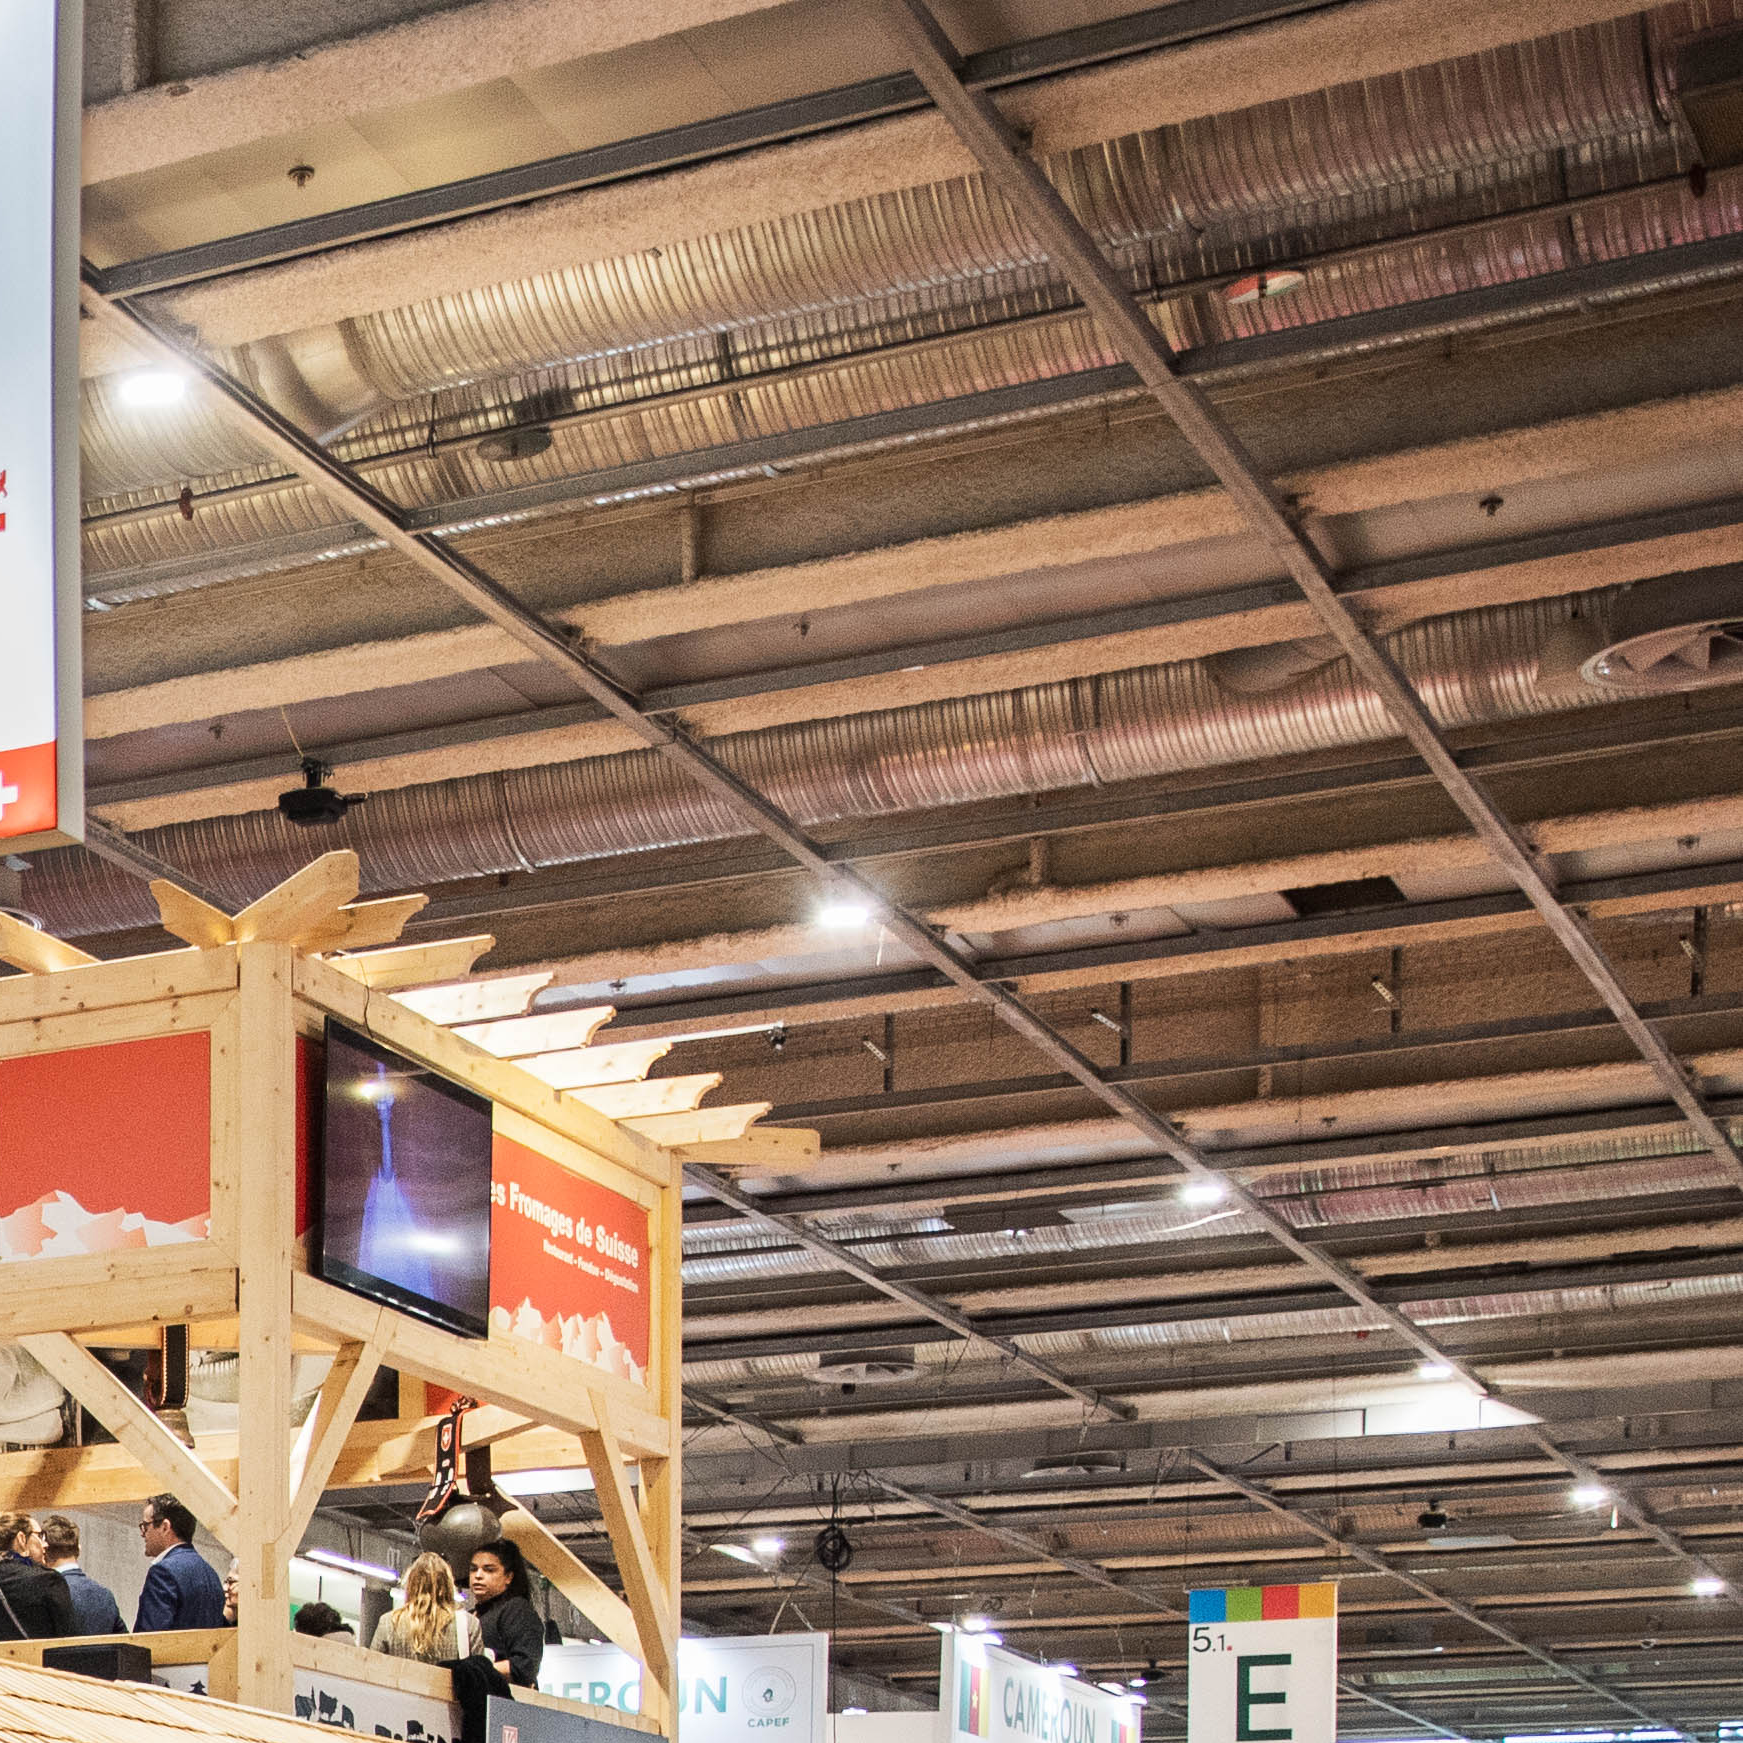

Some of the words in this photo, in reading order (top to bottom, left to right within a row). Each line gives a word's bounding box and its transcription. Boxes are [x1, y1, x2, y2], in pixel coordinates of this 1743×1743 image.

[509, 1182, 573, 1239] Fromages
[576, 1217, 593, 1248] de
[596, 1225, 639, 1268] Suisse
[747, 1717, 791, 1729] CAPEF
[1236, 1654, 1293, 1743] E
